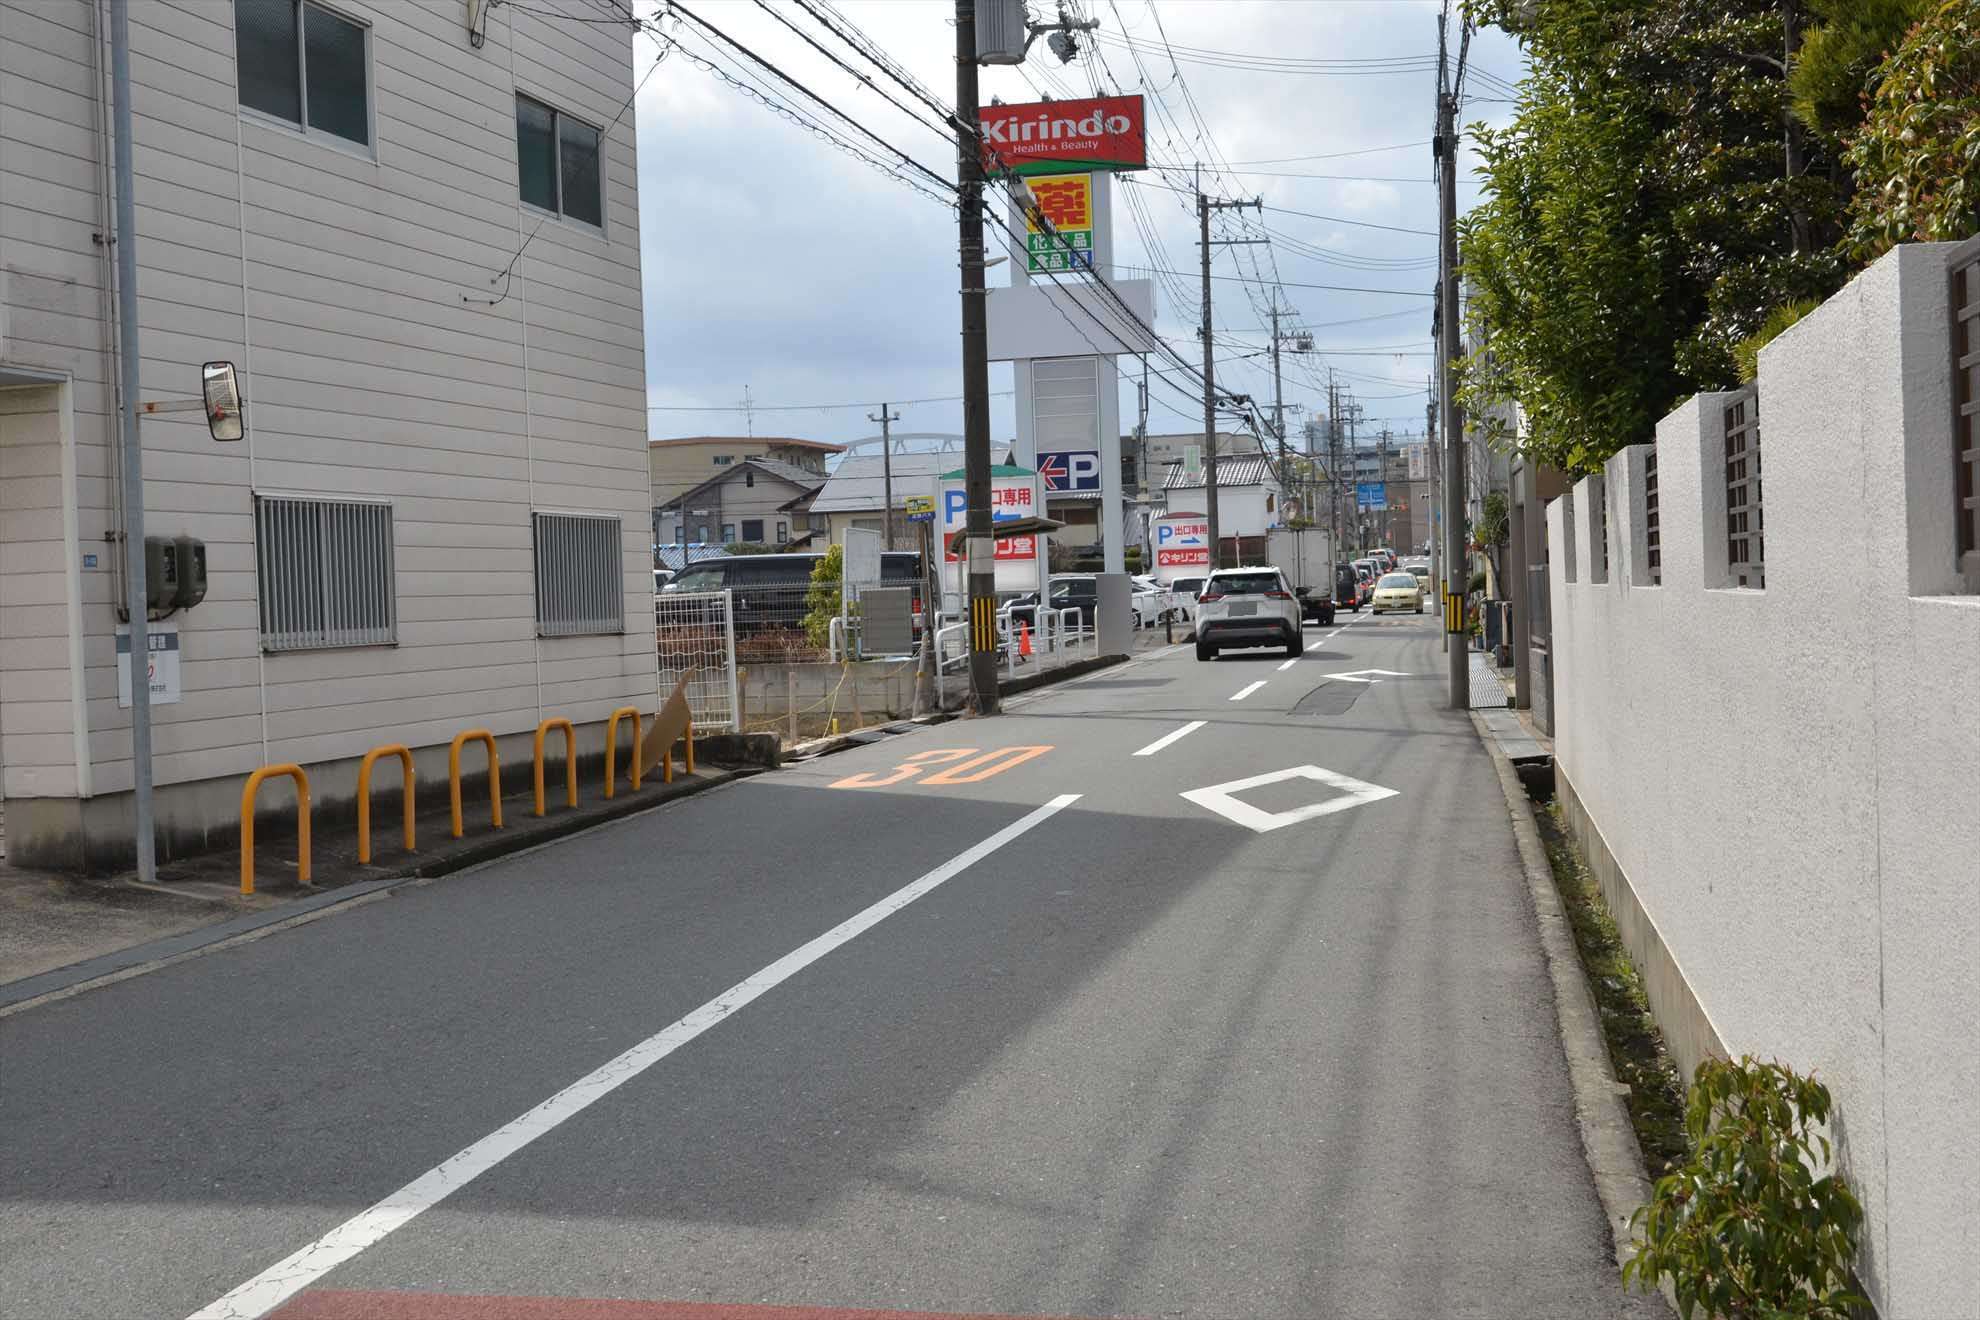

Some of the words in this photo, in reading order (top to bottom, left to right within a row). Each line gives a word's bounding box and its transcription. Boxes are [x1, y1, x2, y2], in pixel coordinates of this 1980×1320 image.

[981, 109, 1131, 144] Kirindo
[1013, 143, 1048, 153] Health
[1061, 139, 1099, 151] Beauty
[1032, 181, 1086, 225] 薬
[1069, 454, 1099, 489] P
[945, 490, 968, 524] P
[1158, 526, 1173, 545] P
[827, 745, 1056, 788] 30
